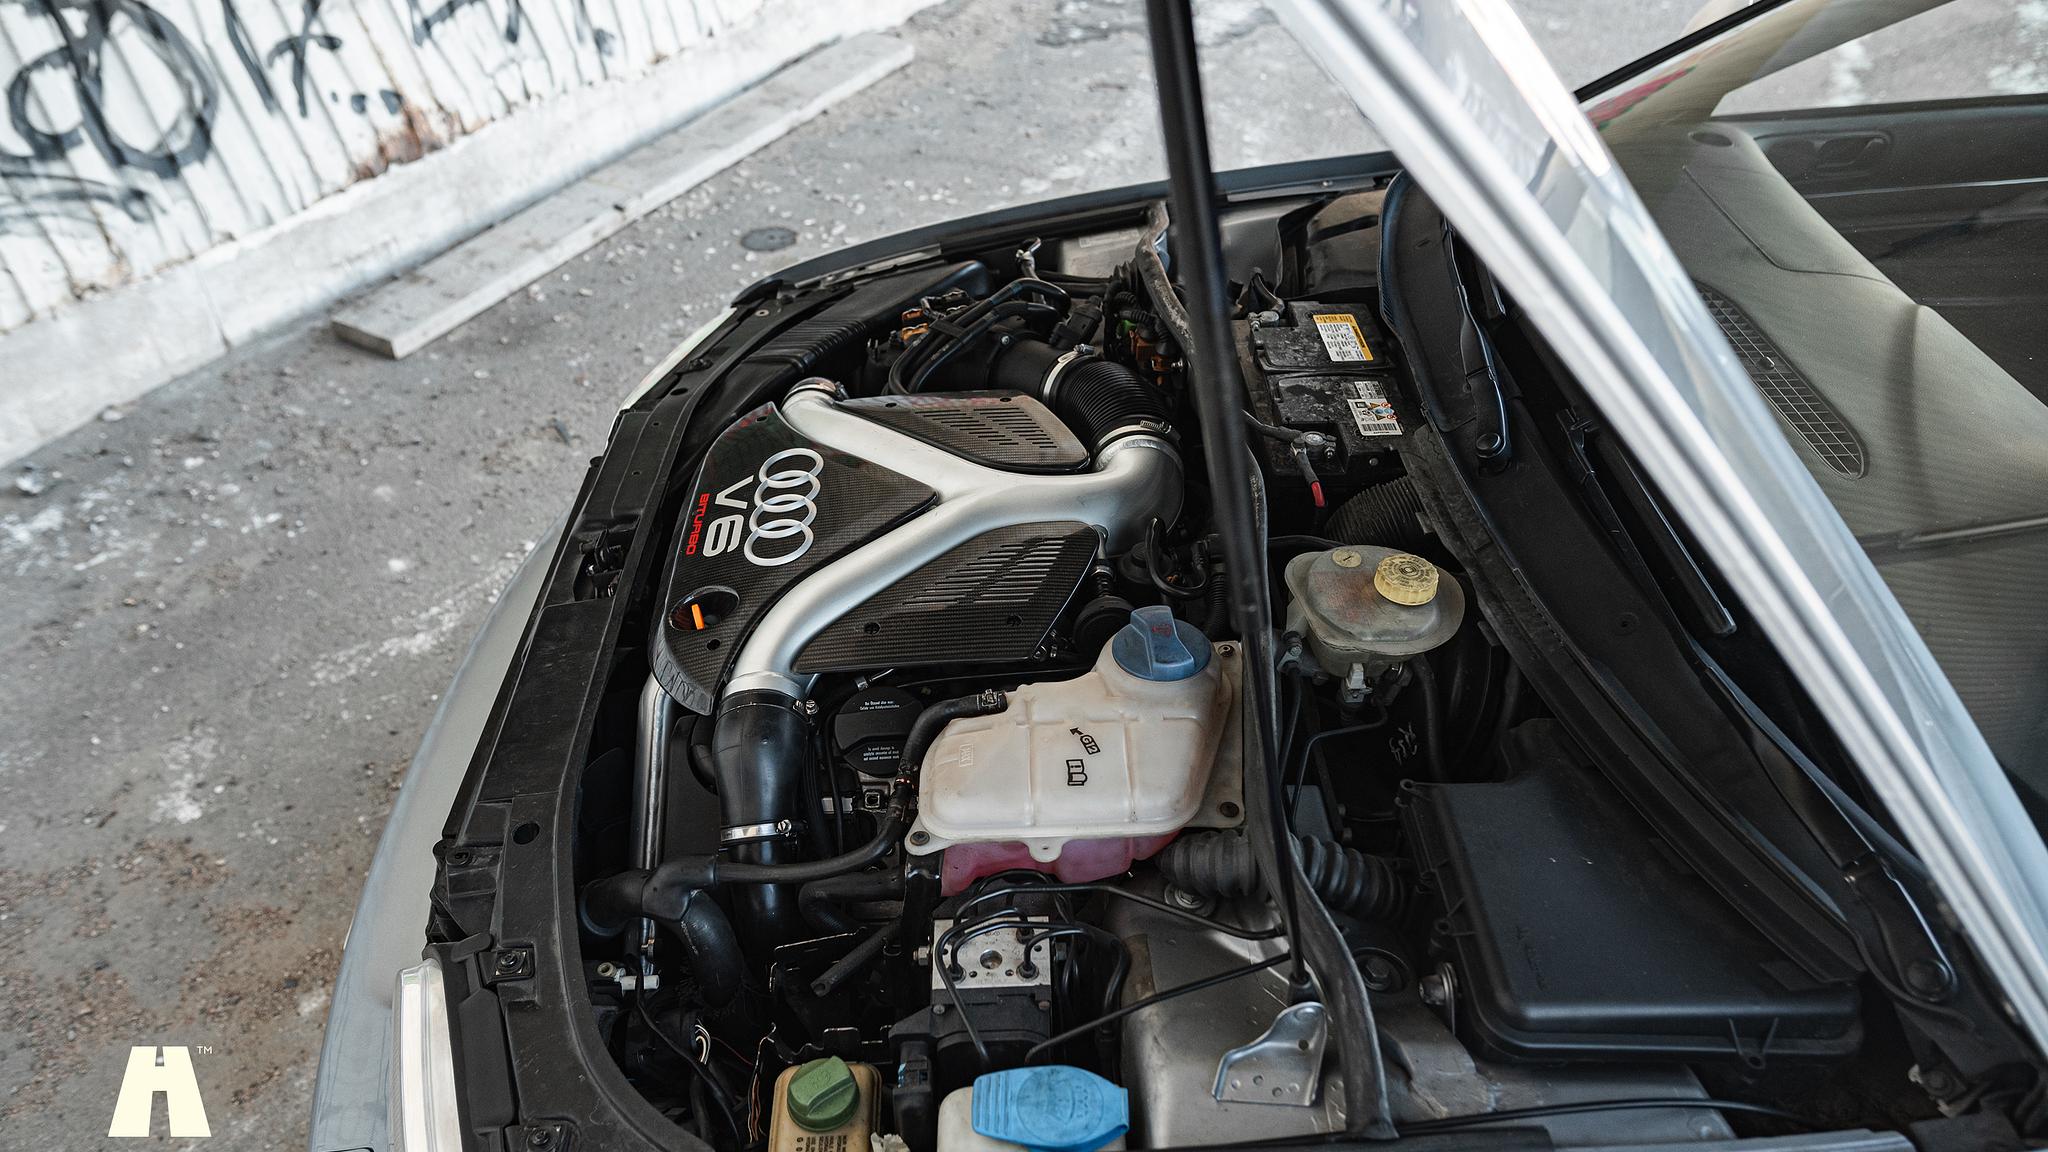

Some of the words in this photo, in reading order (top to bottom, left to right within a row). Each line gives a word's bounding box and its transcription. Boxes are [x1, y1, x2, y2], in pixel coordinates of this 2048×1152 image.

[686, 493, 711, 555] BITURBO
[703, 475, 754, 557] V6
[1081, 735, 1098, 754] G12
